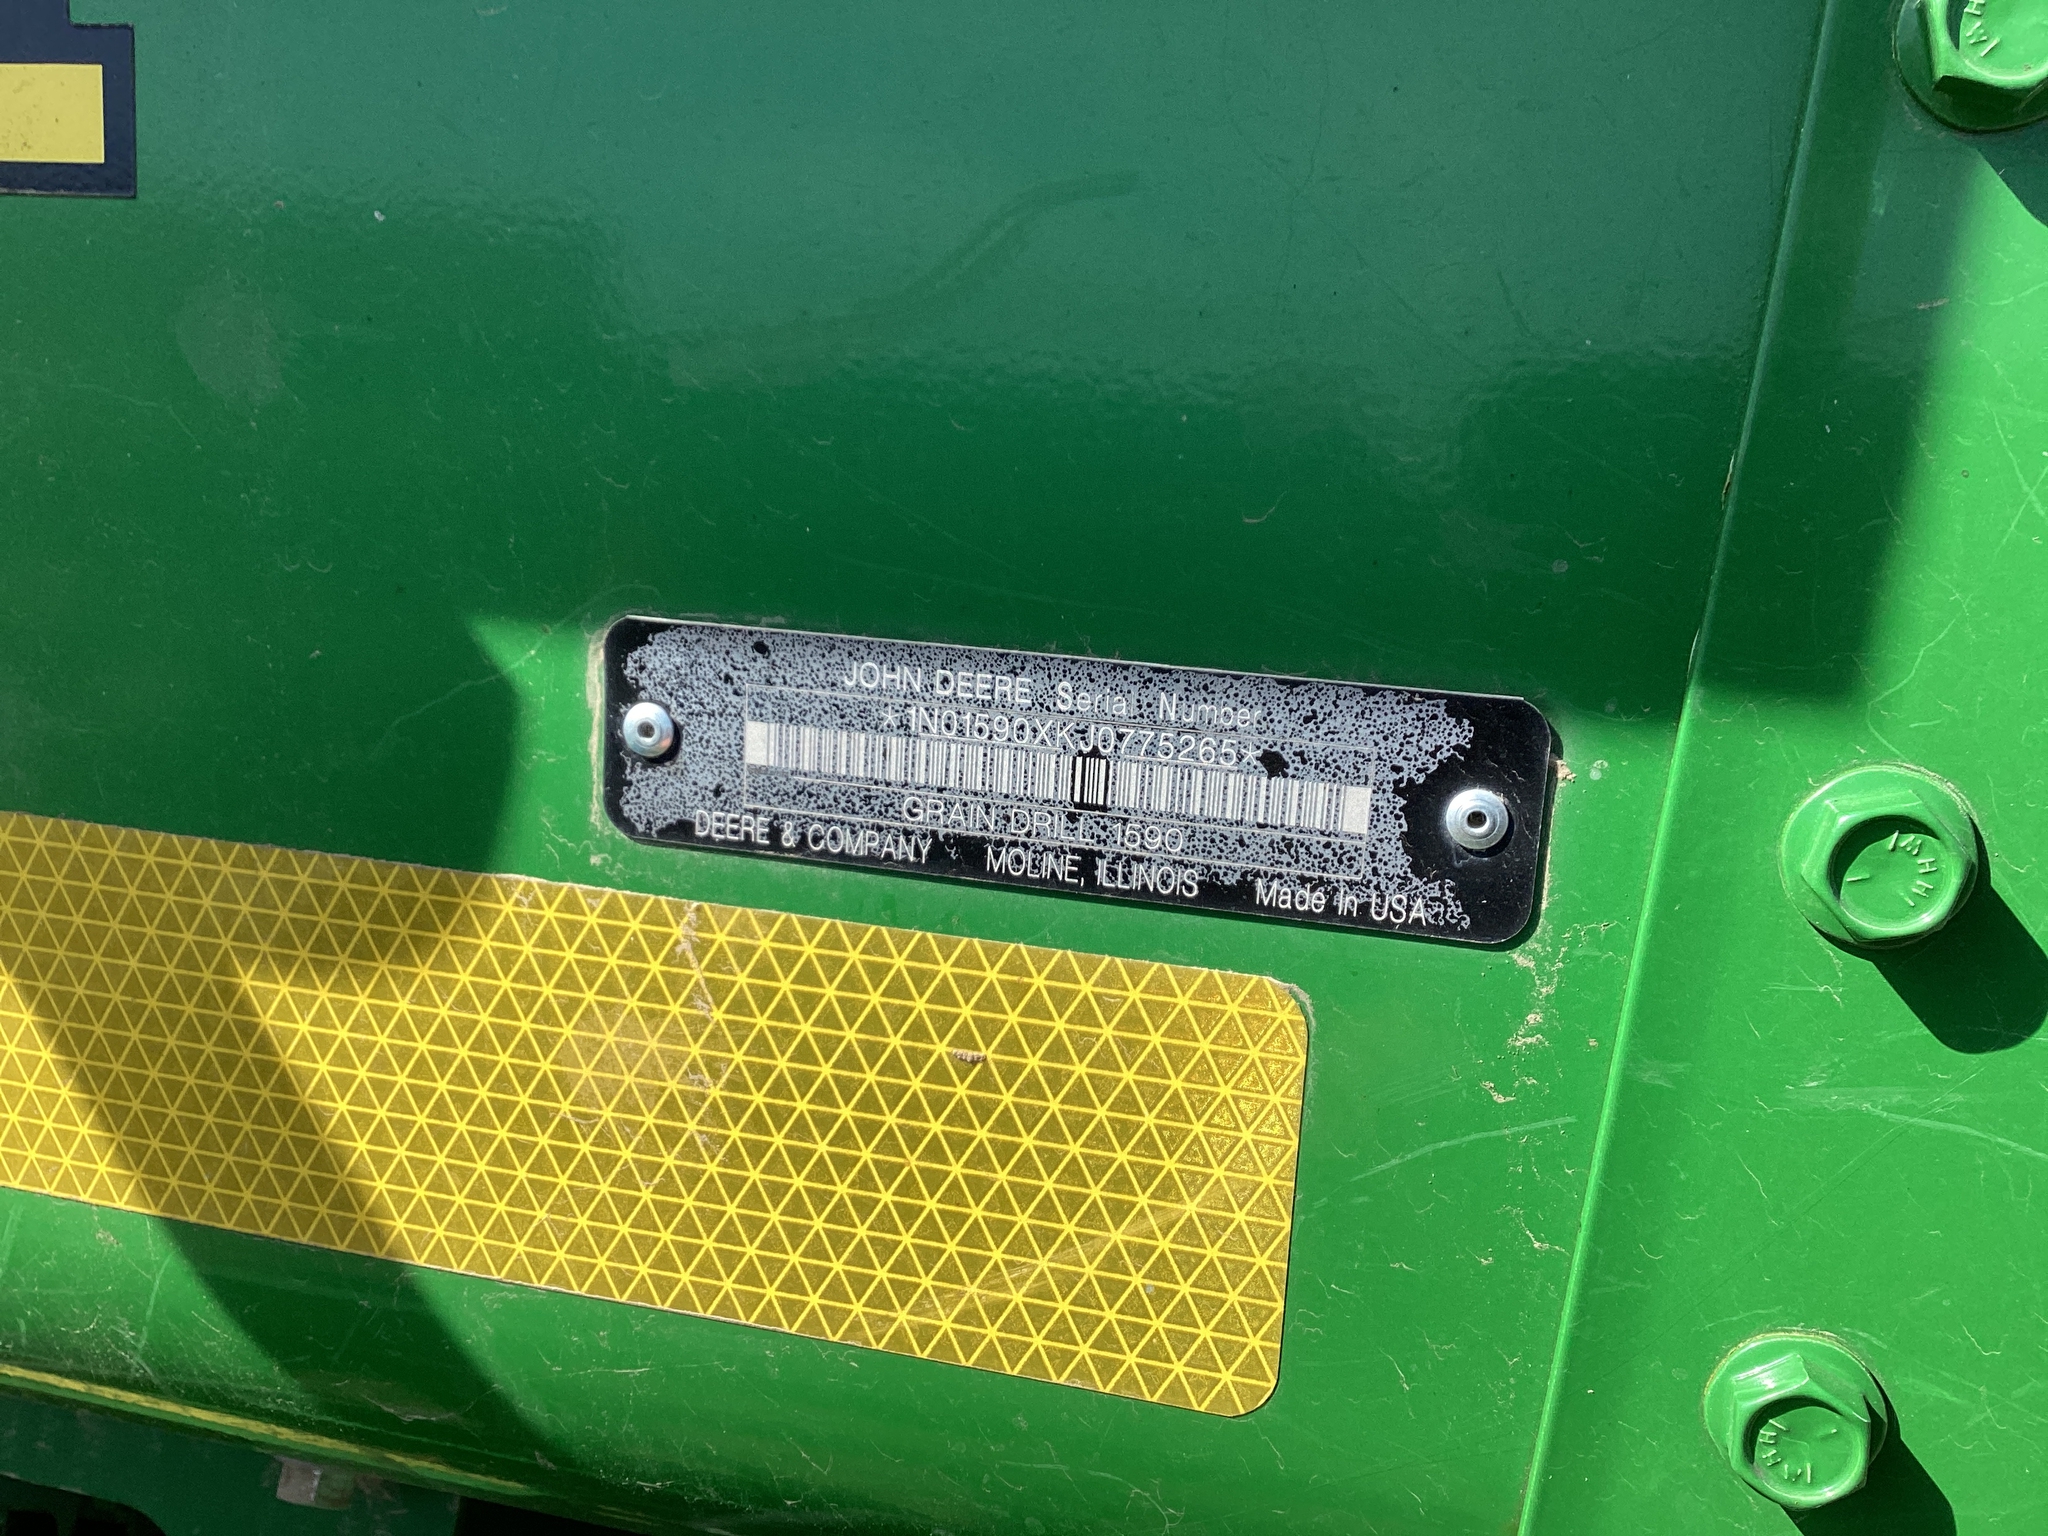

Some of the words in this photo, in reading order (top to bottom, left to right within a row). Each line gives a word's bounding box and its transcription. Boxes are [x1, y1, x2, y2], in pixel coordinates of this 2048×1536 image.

[844, 661, 921, 692] JOHN
[936, 669, 1031, 703] DEERE
[1057, 681, 1135, 716] Serial
[1159, 691, 1262, 729] Number
[903, 796, 995, 832] GRAIN
[1010, 809, 1094, 842] DRILL
[1112, 822, 1183, 852] 1590
[695, 810, 770, 845] DEERE
[781, 821, 796, 848] &
[808, 823, 933, 864] COMPANY
[986, 845, 1084, 887] MOLINE,
[1097, 859, 1199, 898] ILLINOIS
[1255, 878, 1326, 913] Made
[1371, 892, 1427, 927] USA
